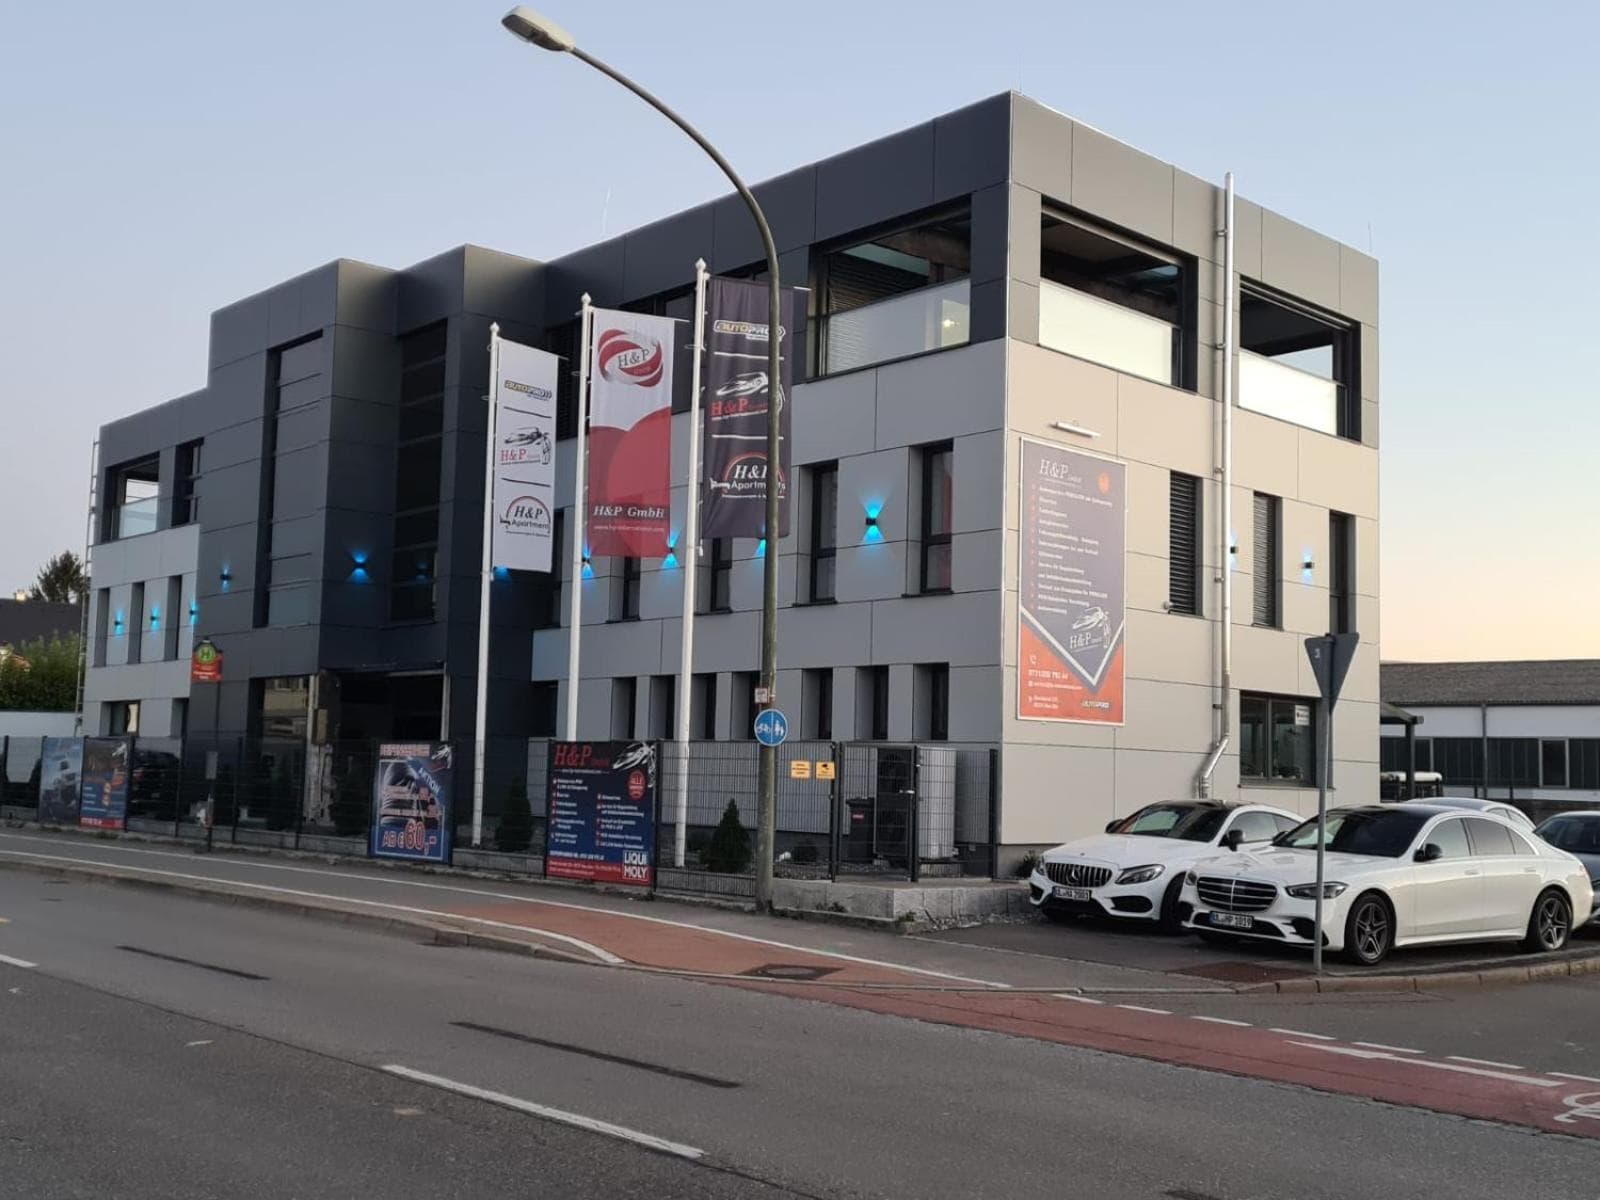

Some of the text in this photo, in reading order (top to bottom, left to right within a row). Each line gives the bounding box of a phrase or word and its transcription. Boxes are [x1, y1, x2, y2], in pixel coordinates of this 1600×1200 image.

[618, 348, 650, 369] H&P
[712, 398, 748, 415] H&P
[501, 448, 527, 461] H&P
[1040, 460, 1068, 479] H&P
[731, 480, 786, 491] Apartmts
[514, 505, 543, 519] H&P
[594, 505, 664, 518] H&P GmbH
[1070, 632, 1091, 649] H&P
[554, 744, 592, 766] H&P
[623, 865, 648, 879] MOLY
